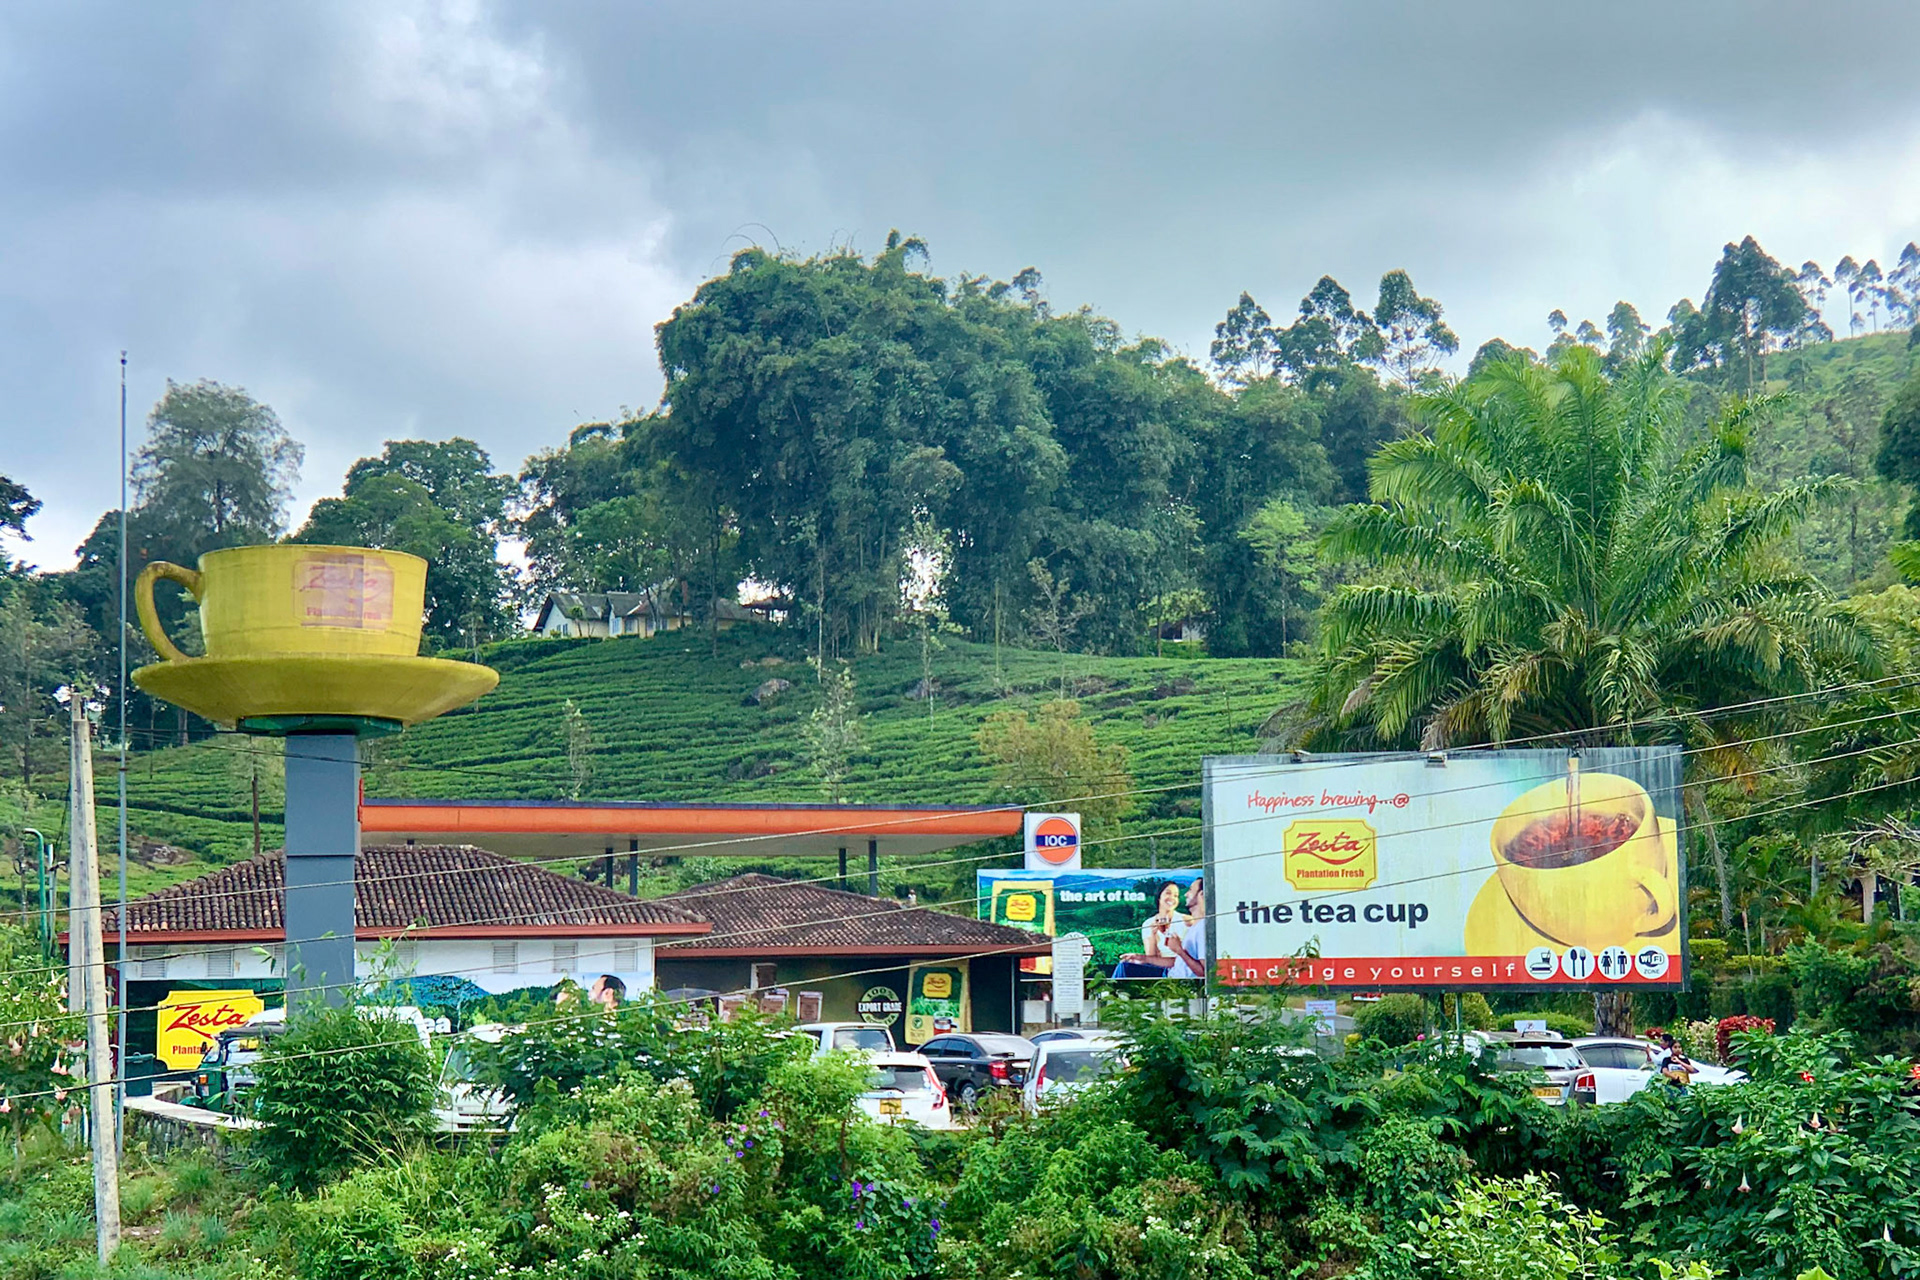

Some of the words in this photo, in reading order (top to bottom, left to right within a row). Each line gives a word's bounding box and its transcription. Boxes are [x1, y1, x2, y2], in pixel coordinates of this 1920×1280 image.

[1248, 790, 1315, 813] Happiness
[1045, 835, 1067, 847] IOC
[1290, 832, 1370, 865] Zesta
[1297, 869, 1339, 878] Plantation
[1341, 868, 1364, 878] Fresh
[1060, 890, 1083, 902] the
[1084, 890, 1105, 902] art
[1107, 890, 1122, 902] of
[1123, 890, 1145, 902] tea
[1236, 901, 1292, 923] the
[1299, 900, 1356, 923] tea
[1364, 903, 1429, 928] cup
[1231, 965, 1355, 981] indulge
[1370, 963, 1515, 980] yourself
[858, 1002, 881, 1013] EXPORT
[165, 1004, 246, 1039] Zesta
